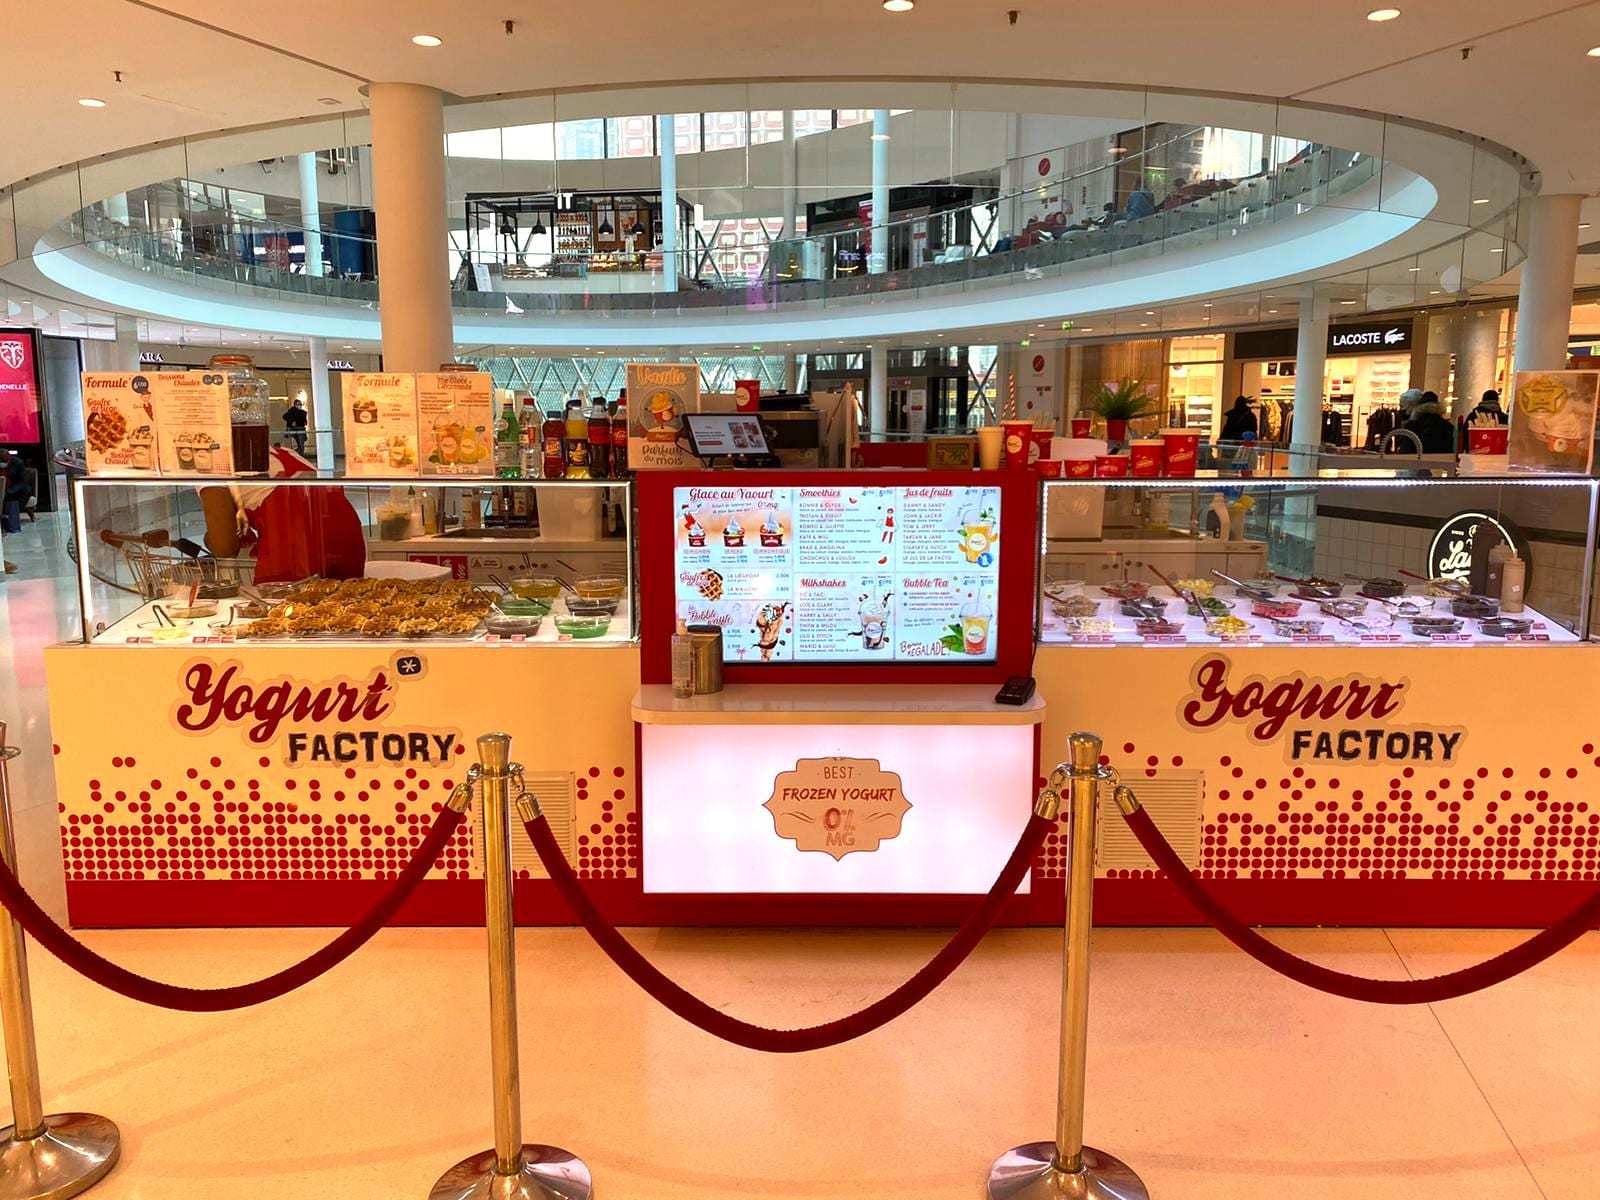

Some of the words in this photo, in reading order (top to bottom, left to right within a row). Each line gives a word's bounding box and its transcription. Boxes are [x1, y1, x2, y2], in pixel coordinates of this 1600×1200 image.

[1333, 332, 1381, 346] LACOSTE
[139, 352, 164, 362] ARA
[327, 360, 354, 368] ARA
[85, 376, 128, 388] Formule
[656, 456, 683, 466] mois
[689, 488, 719, 502] Glace
[720, 490, 734, 499] au
[737, 488, 774, 499] Yaourt
[800, 488, 841, 498] Smoothies
[919, 489, 928, 497] de
[928, 488, 952, 498] fruits
[800, 578, 846, 588] Milkshakes
[903, 578, 932, 588] Bubble
[933, 578, 949, 588] Tea
[176, 663, 392, 743] Yogurt
[288, 732, 456, 762] FACTORY
[1292, 730, 1462, 760] FACTORY
[824, 766, 854, 780] BEST
[782, 788, 837, 802] FROZEN
[841, 788, 897, 802] YOGURT
[824, 808, 856, 832] 0%
[826, 832, 856, 847] MG
